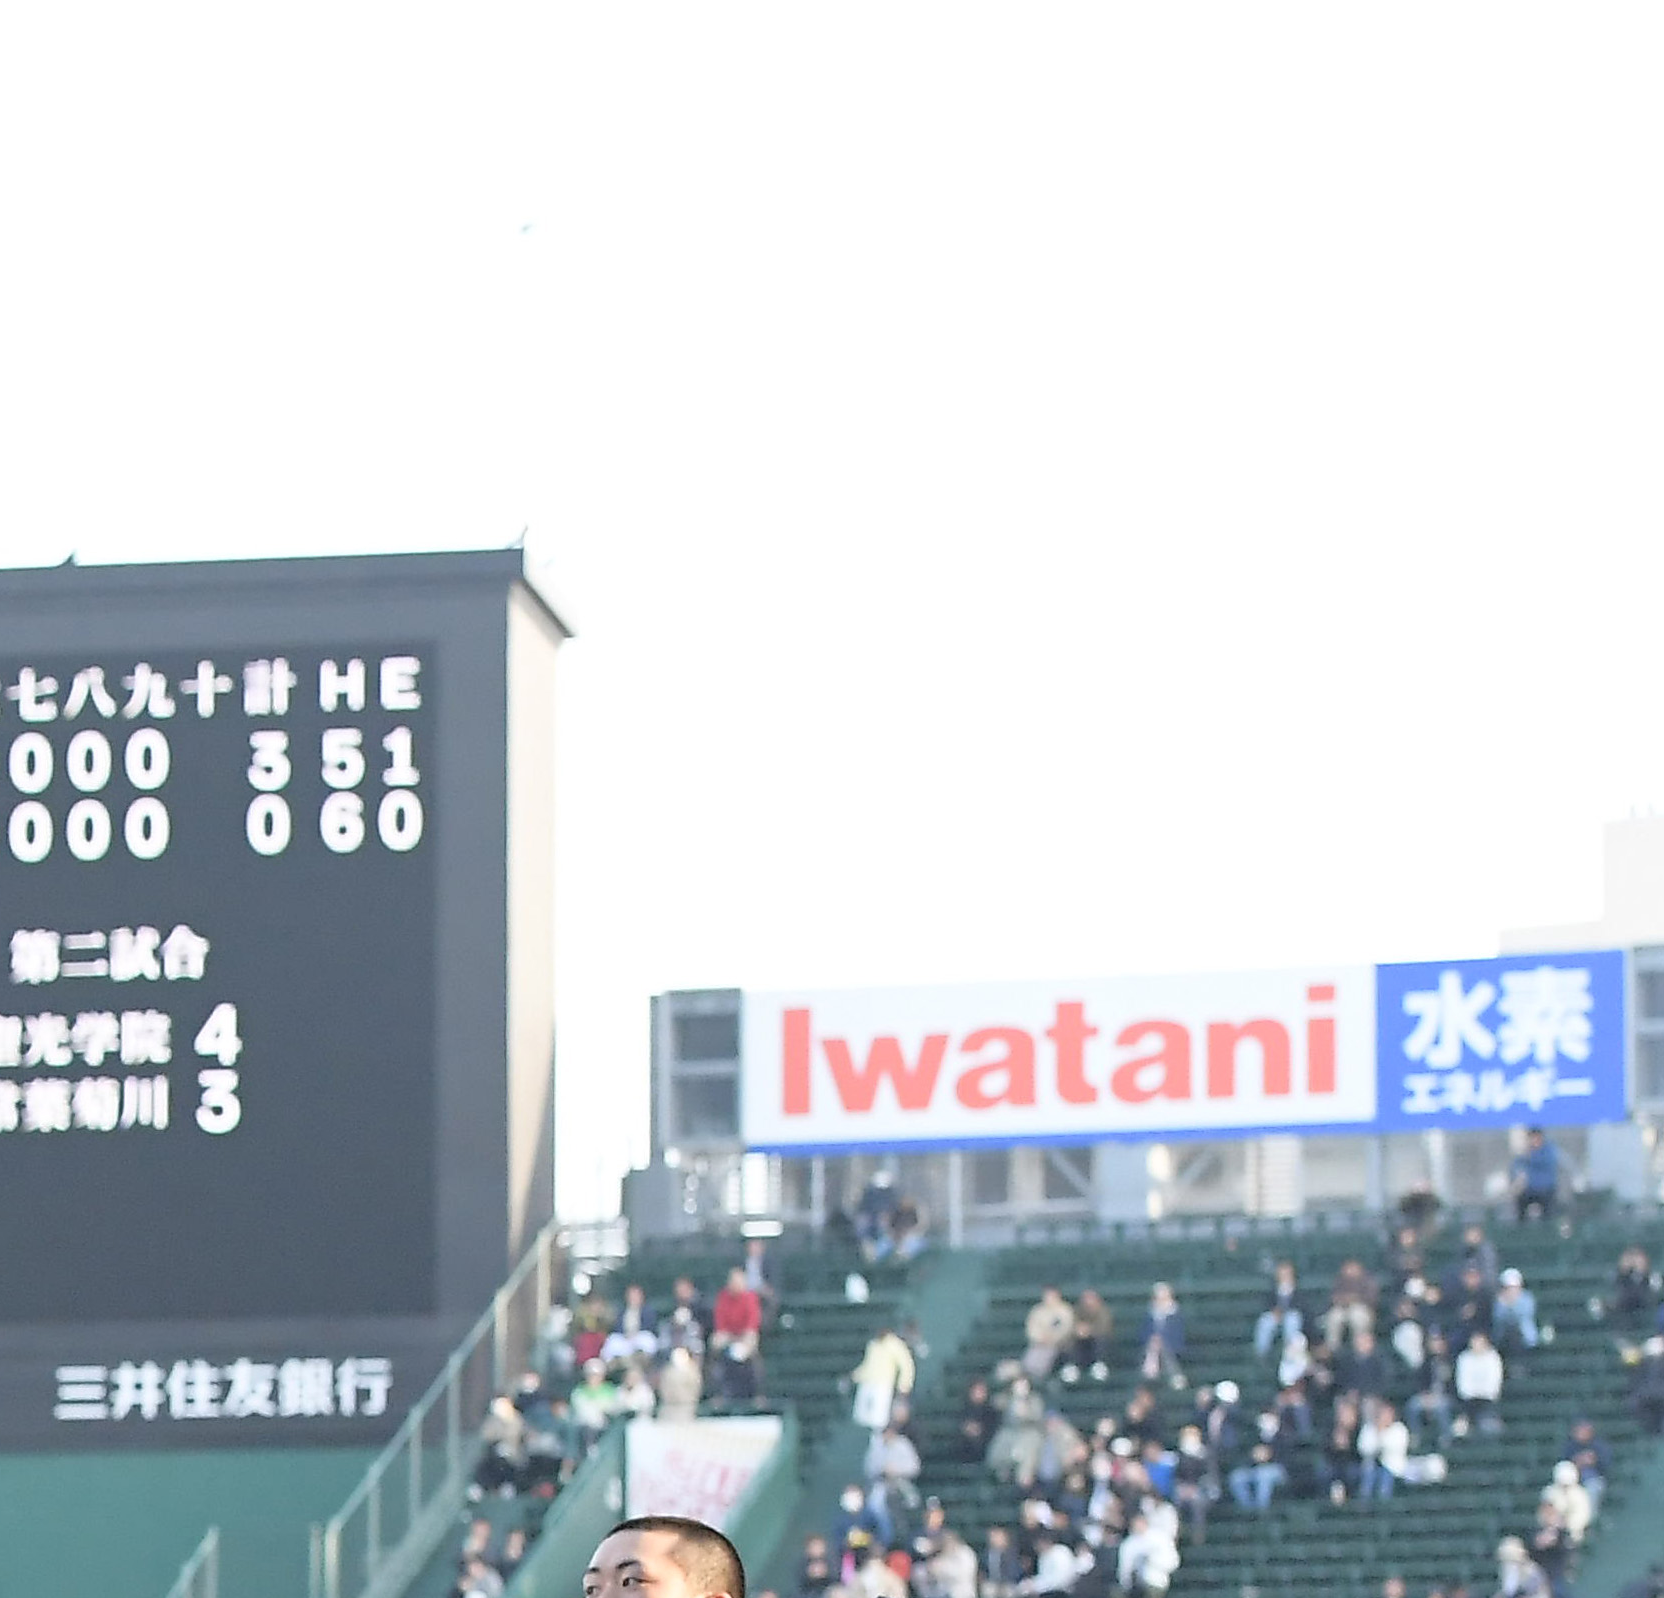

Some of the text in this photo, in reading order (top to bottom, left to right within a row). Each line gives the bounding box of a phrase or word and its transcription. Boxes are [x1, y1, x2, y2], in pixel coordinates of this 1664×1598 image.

[10, 925, 209, 984] 第二試合
[195, 1003, 243, 1065] 4
[1401, 966, 1594, 1070] 水素
[783, 986, 1335, 1116] Iwatani
[196, 1069, 241, 1134] 3
[1400, 1066, 1595, 1115] エネルギー
[56, 1357, 391, 1421] 三井住友銀行
